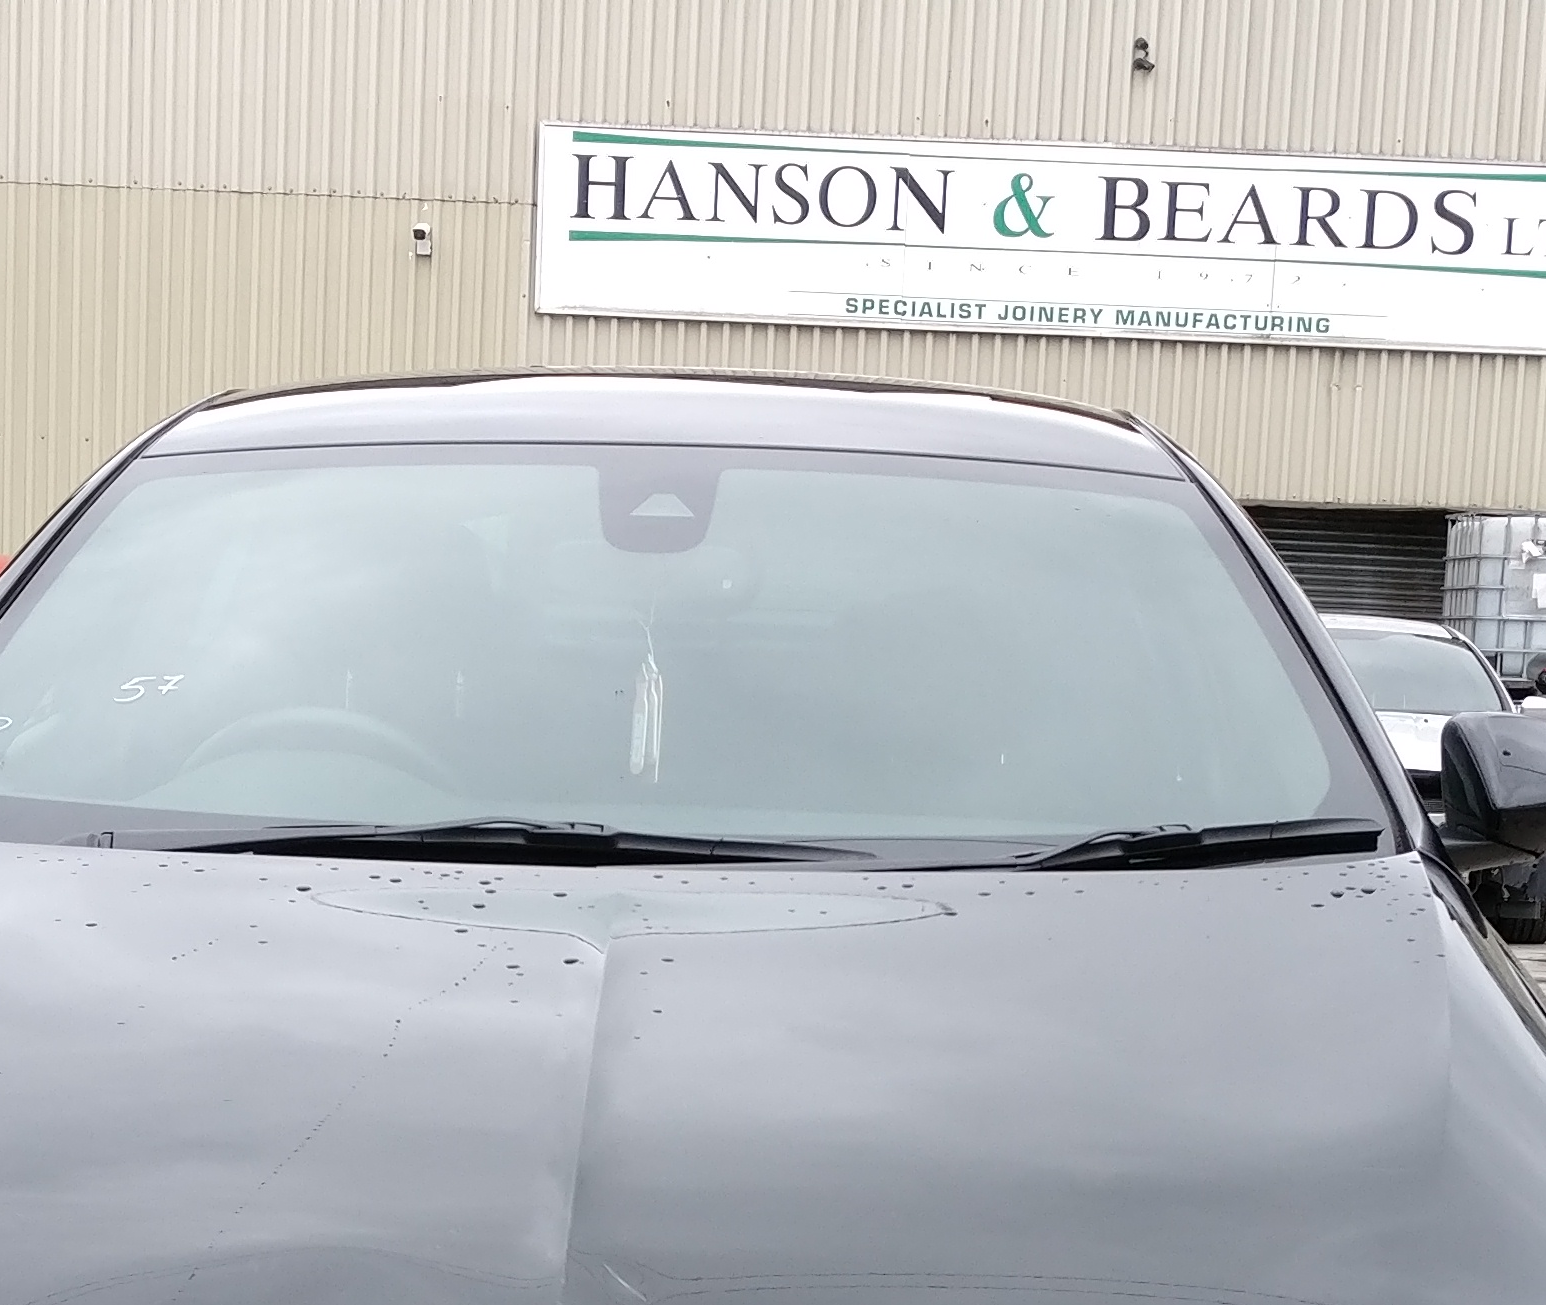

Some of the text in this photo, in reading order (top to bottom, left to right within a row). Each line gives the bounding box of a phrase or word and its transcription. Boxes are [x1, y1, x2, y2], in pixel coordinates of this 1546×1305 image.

[569, 153, 956, 236] HANSON
[992, 172, 1055, 239] &
[1094, 175, 1478, 256] BEARDS
[844, 297, 1331, 334] SPECIALIST JOINERY MANUFACTURING
